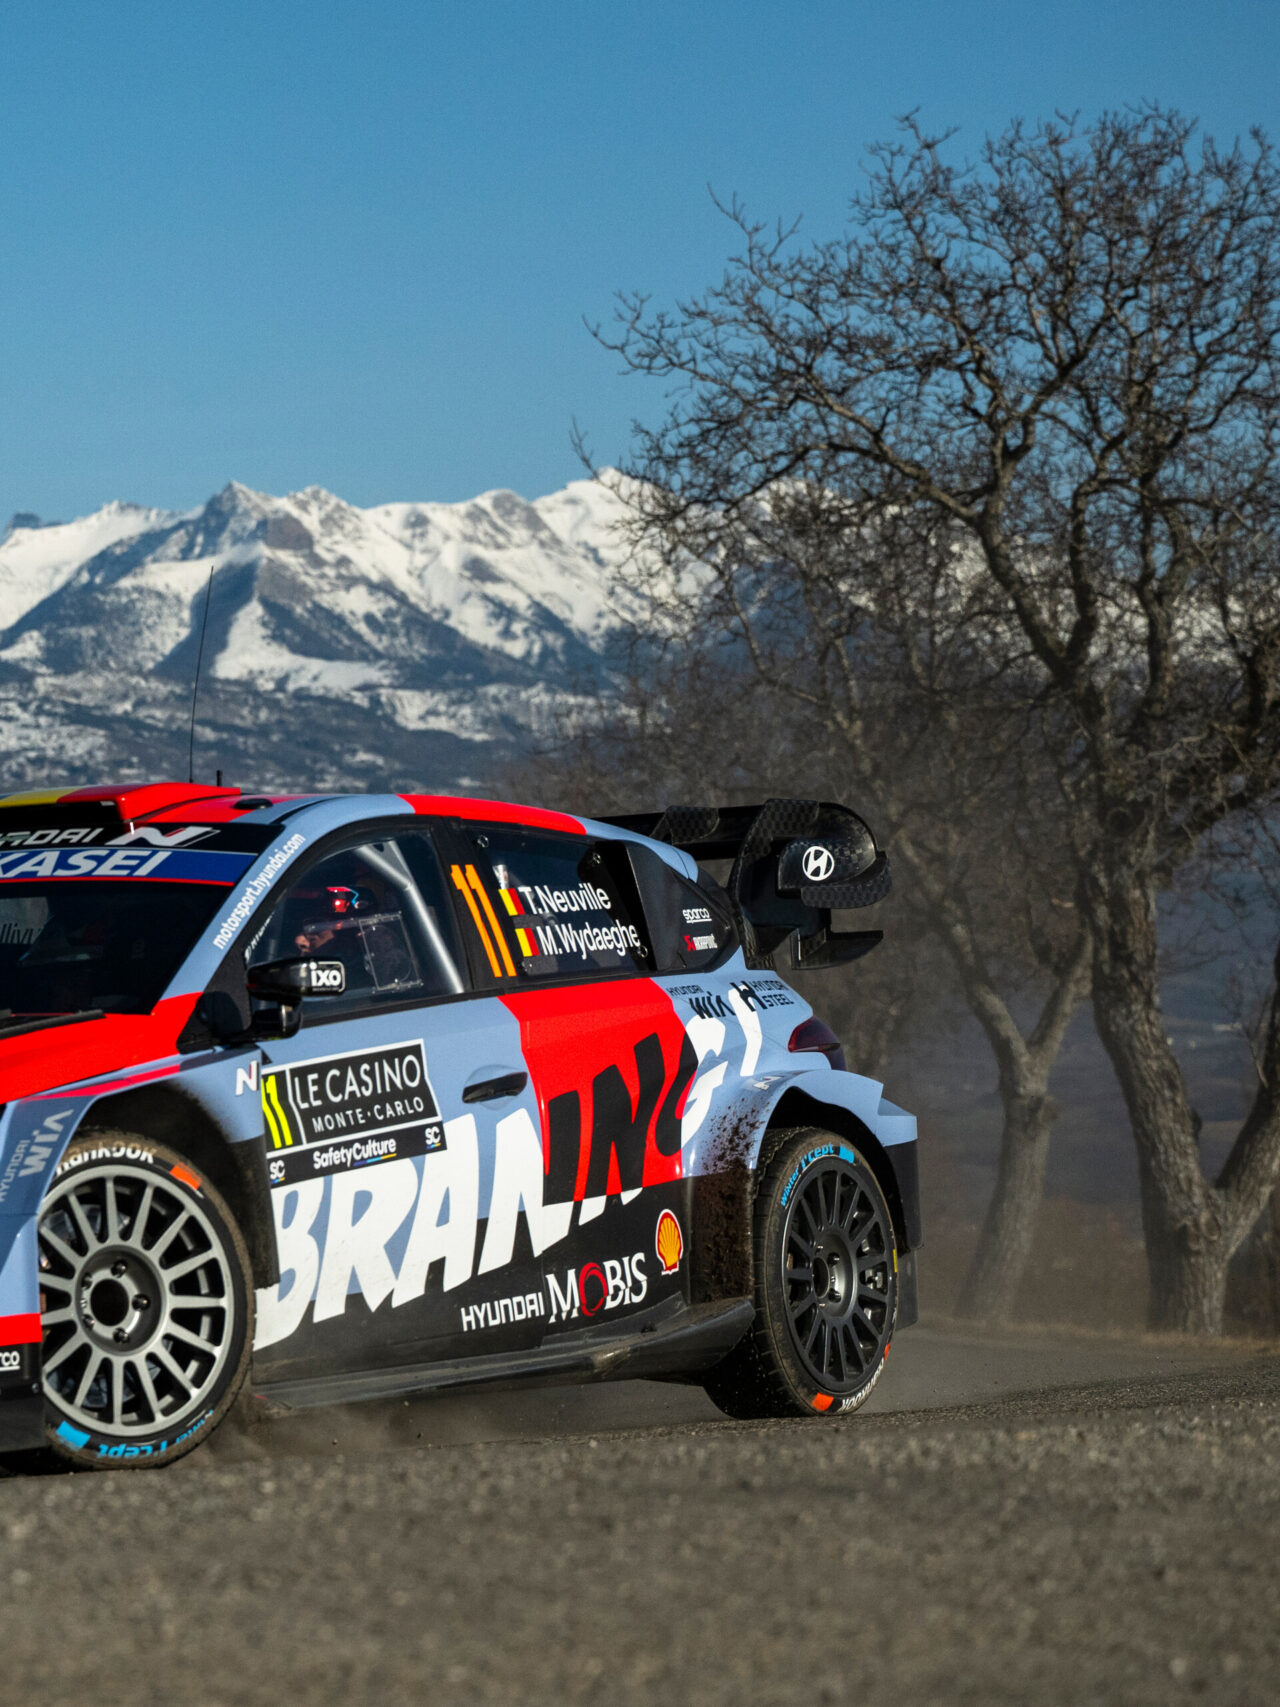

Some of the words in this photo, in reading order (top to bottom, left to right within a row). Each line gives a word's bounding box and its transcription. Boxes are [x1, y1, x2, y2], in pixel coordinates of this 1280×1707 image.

[213, 833, 306, 950] motorsport.hyundai.com
[518, 882, 612, 915] T.Neuville
[451, 864, 517, 978] 11
[309, 962, 342, 987] ixo
[761, 993, 795, 1007] STEEL
[294, 1072, 322, 1109] LE
[325, 1054, 421, 1103] CASINO
[270, 1160, 286, 1180] SC
[313, 1138, 397, 1170] SafetyCulture
[425, 1126, 441, 1146] SC
[460, 1291, 545, 1332] HYUNDAI
[545, 1252, 649, 1324] MOBIS
